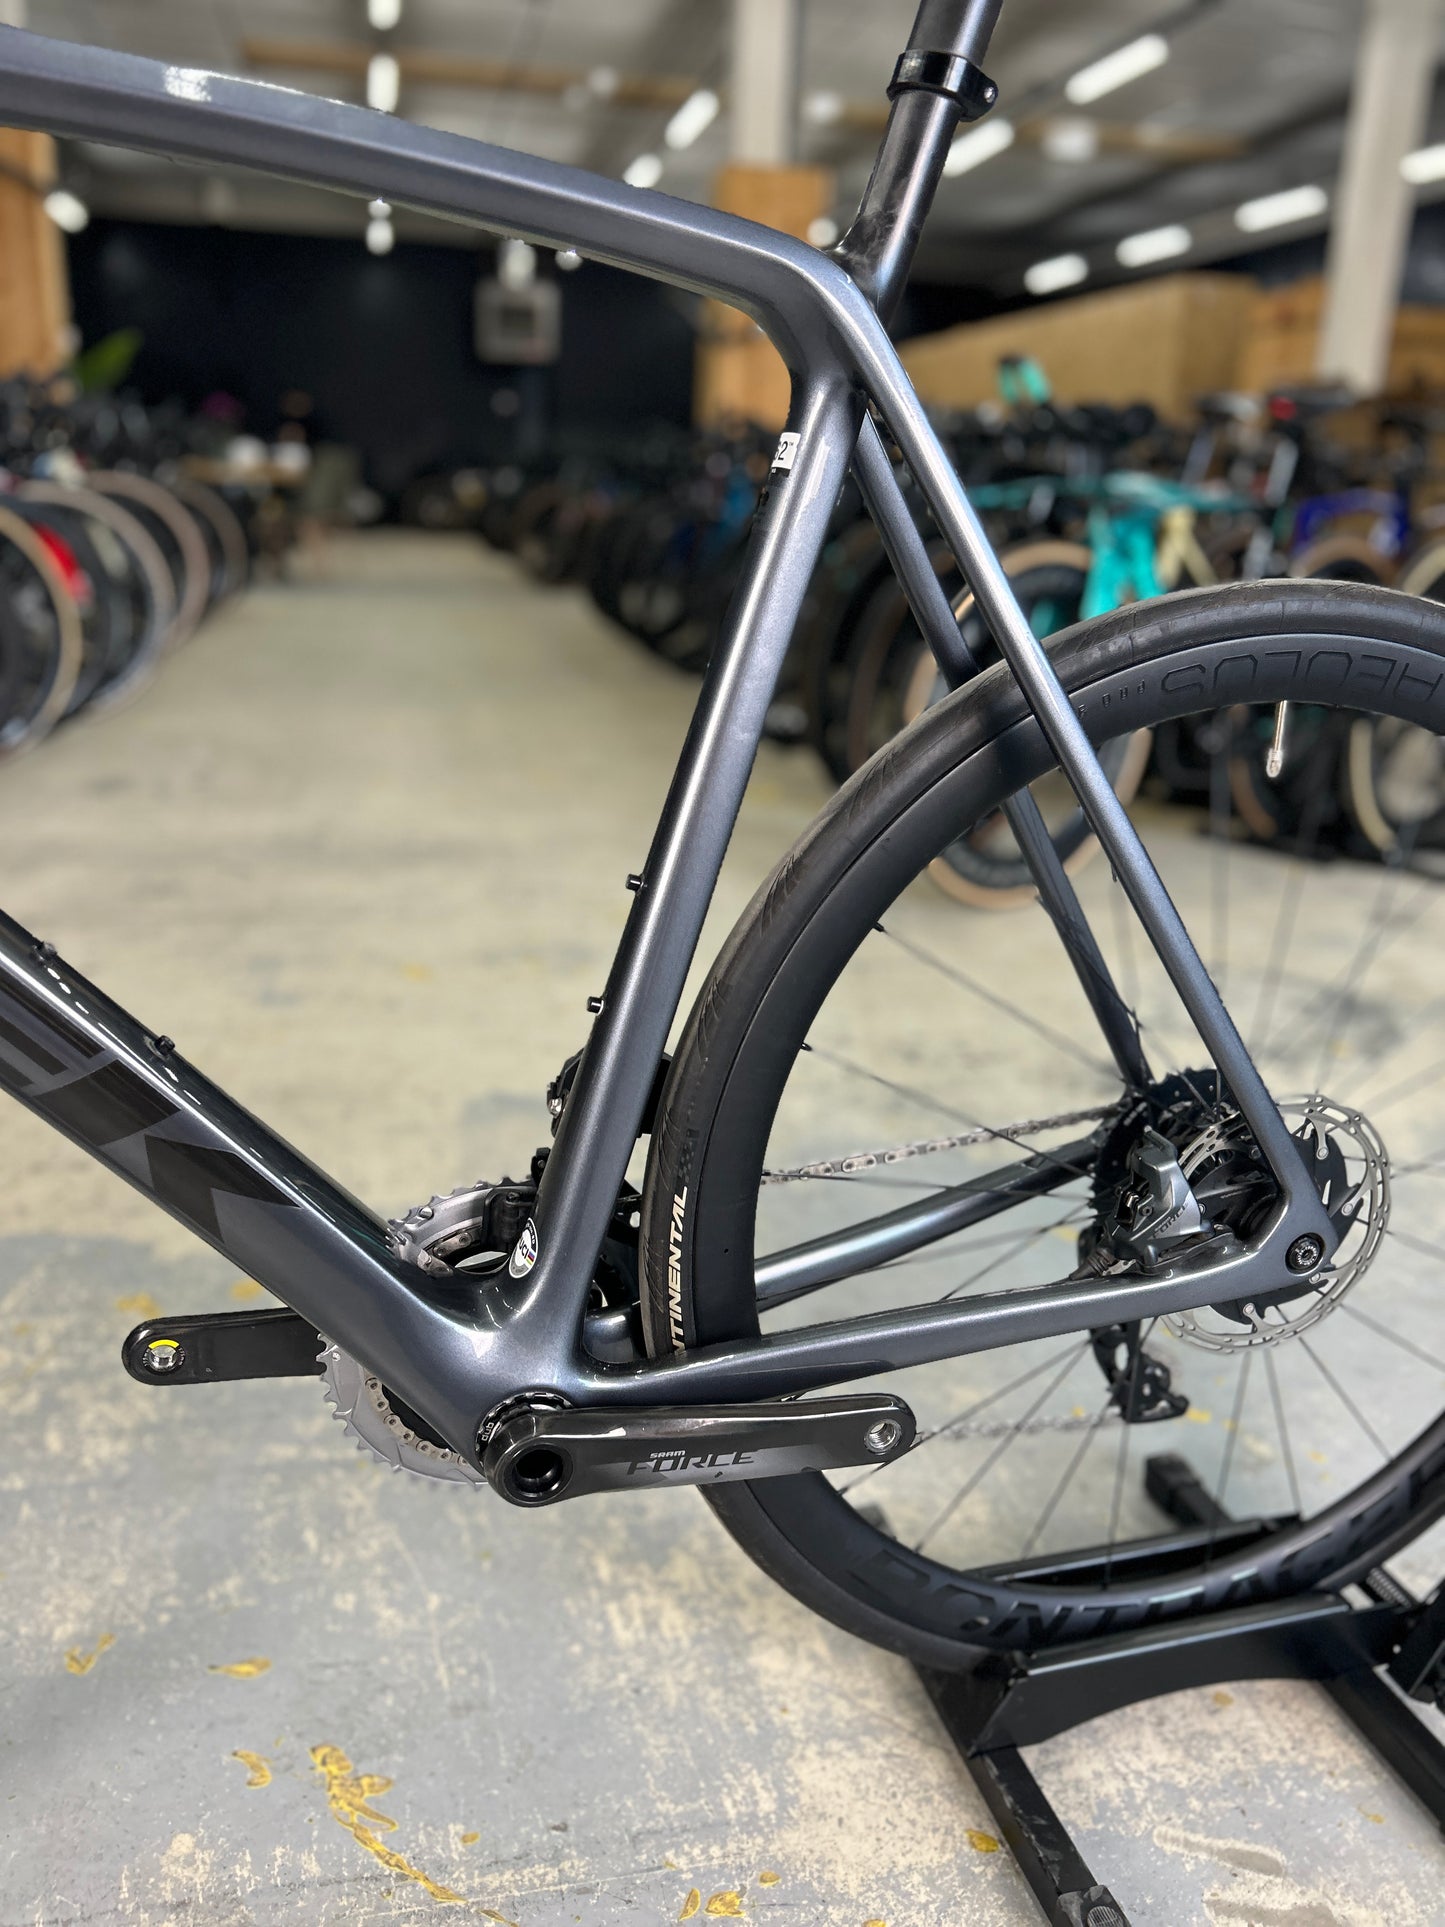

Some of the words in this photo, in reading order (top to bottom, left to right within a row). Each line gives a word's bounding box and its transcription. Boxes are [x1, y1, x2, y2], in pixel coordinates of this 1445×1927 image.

[1160, 650, 1443, 701] AEOLUS
[481, 1422, 495, 1442] dub
[627, 1451, 755, 1475] FORCE
[650, 1450, 686, 1459] SRAM
